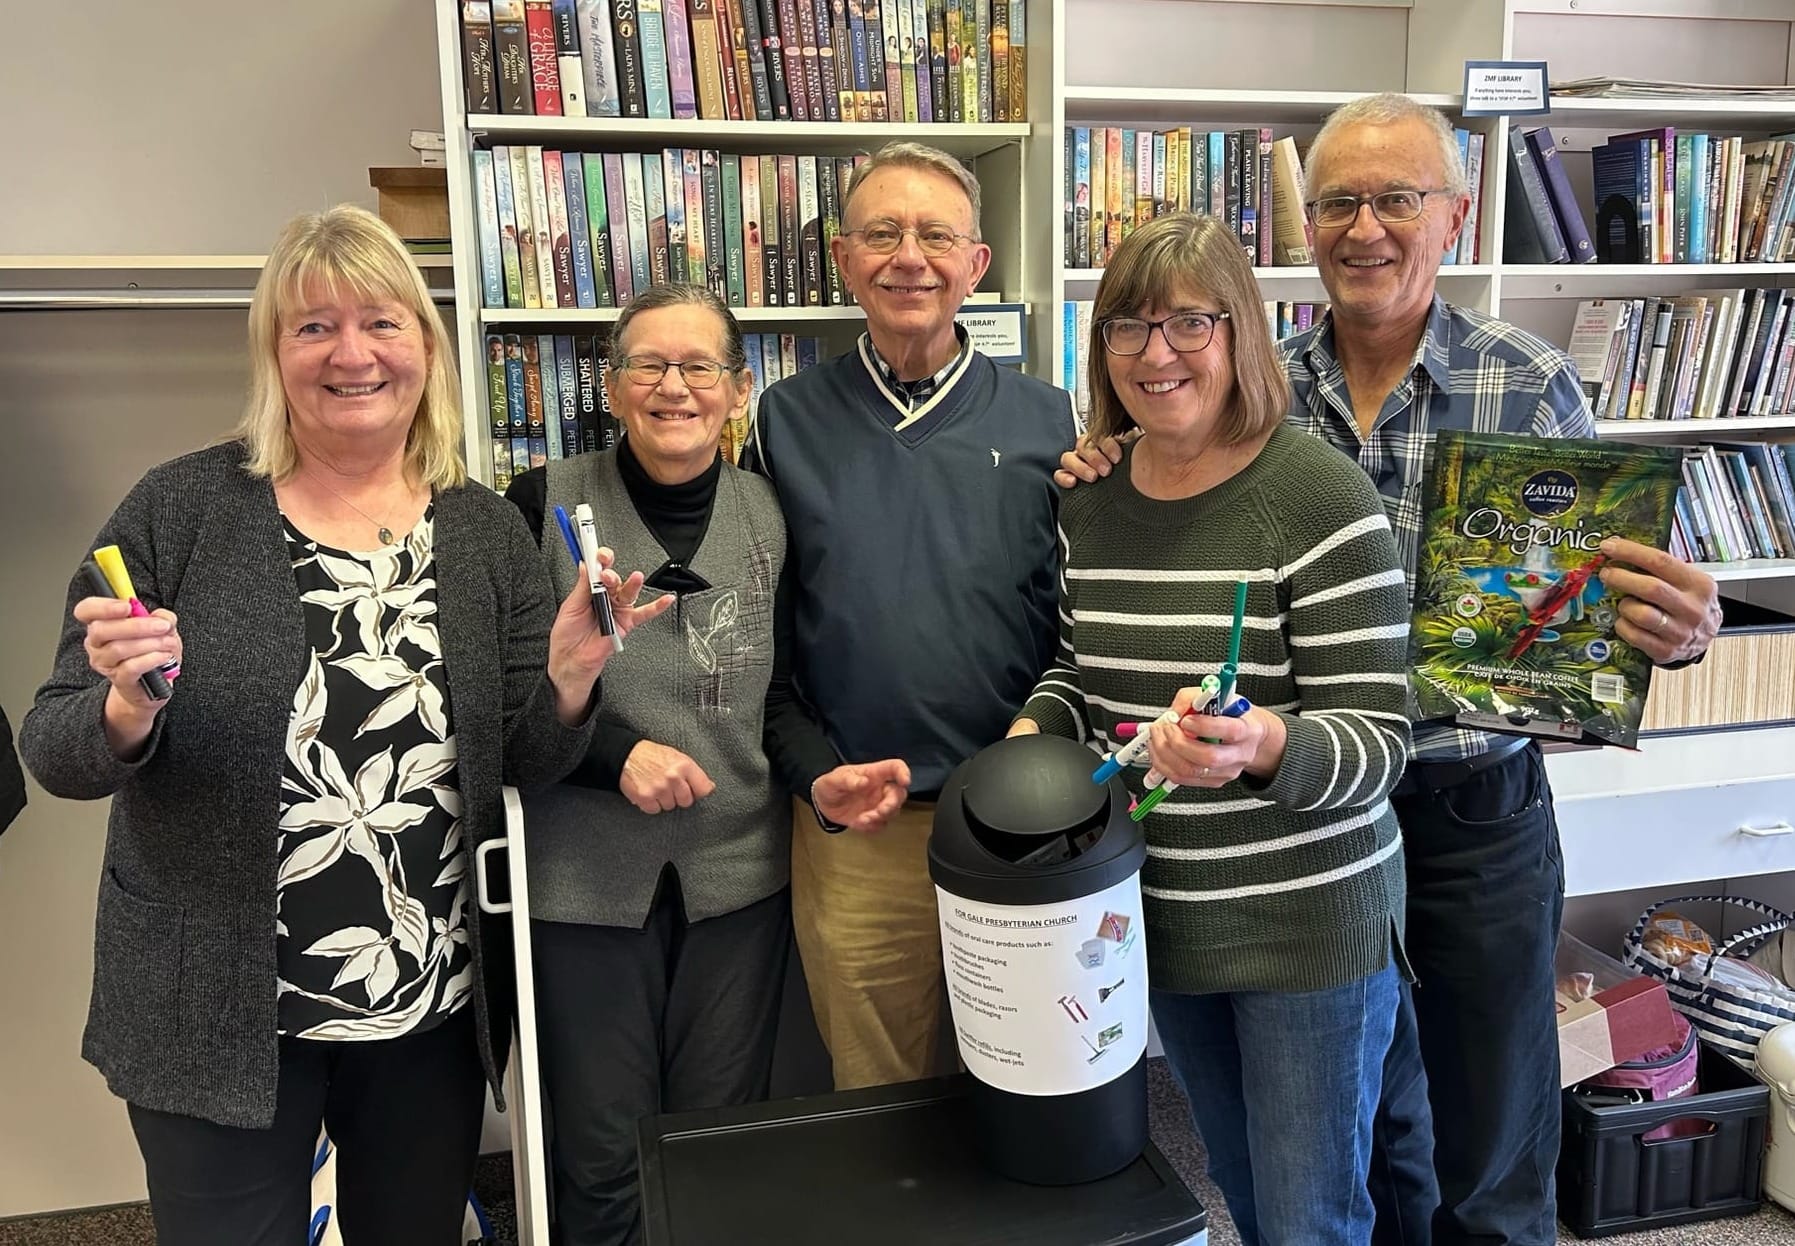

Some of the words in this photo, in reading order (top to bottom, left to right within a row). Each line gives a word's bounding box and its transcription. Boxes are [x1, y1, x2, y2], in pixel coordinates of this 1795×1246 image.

[561, 14, 571, 45] RIVERS
[644, 17, 659, 48] BRIDGE
[855, 31, 863, 46] OUT
[979, 19, 987, 52] SECRETS
[590, 34, 607, 89] MASTERPIECE
[838, 37, 847, 62] SHADOW
[869, 31, 877, 67] MIDNIGHT
[530, 42, 548, 91] GRACE
[543, 42, 559, 91] LINEAGE
[649, 61, 663, 90] HAVEN
[772, 52, 783, 81] RIVERS
[789, 59, 800, 104] PETERSON
[796, 66, 804, 97] TRACIE
[805, 59, 816, 104] PETERSON
[812, 66, 821, 97] TRACIE
[822, 59, 833, 104] PETERSON
[828, 66, 837, 97] TRACIE
[857, 62, 866, 83] ASHES
[979, 61, 988, 102] PETERSON
[755, 76, 767, 104] RIVERS
[708, 184, 715, 193] IN
[596, 232, 608, 271] Sawyer
[615, 233, 627, 272] Sawyer
[710, 218, 718, 256] HEARTBEAT
[488, 243, 499, 281] Sawyer
[558, 246, 571, 285] Sawyer
[576, 240, 589, 279] Sawyer
[654, 246, 667, 285] Sawyer
[729, 247, 740, 282] Sawyer
[750, 256, 760, 289] Sawyer
[768, 258, 779, 289] Sawyer
[784, 258, 796, 290] Sawyer
[806, 250, 818, 282] Sawyer
[966, 319, 996, 327] LIBRARY
[1630, 323, 1638, 343] BLIND
[1625, 344, 1635, 372] DESCENT
[560, 358, 575, 420] SUBMERGED
[579, 358, 594, 413] SHATTERED
[1577, 450, 1602, 460] World
[1583, 461, 1611, 469] monde
[1524, 483, 1576, 498] ZAVIDA
[1462, 507, 1603, 556] Organic
[1467, 664, 1501, 675] PREMIUM
[1502, 667, 1529, 677] WHOLE
[1531, 670, 1553, 680] BEAN
[1554, 673, 1580, 683] COFFEE
[1506, 674, 1529, 683] CHOIX
[1531, 677, 1542, 685] EN
[1543, 680, 1573, 689] GRAINS
[955, 908, 966, 920] FOR
[967, 913, 983, 923] GALE
[985, 917, 1042, 928] PRESBYTERIAN
[1043, 914, 1078, 926] CHURCH
[996, 940, 1025, 948] products
[1026, 940, 1042, 948] such
[965, 968, 992, 981] containers
[978, 954, 1007, 967] packaging
[983, 982, 1004, 993] bottles
[975, 1006, 1002, 1020] packaging
[998, 1005, 1018, 1013] razors
[994, 1045, 1021, 1059] including
